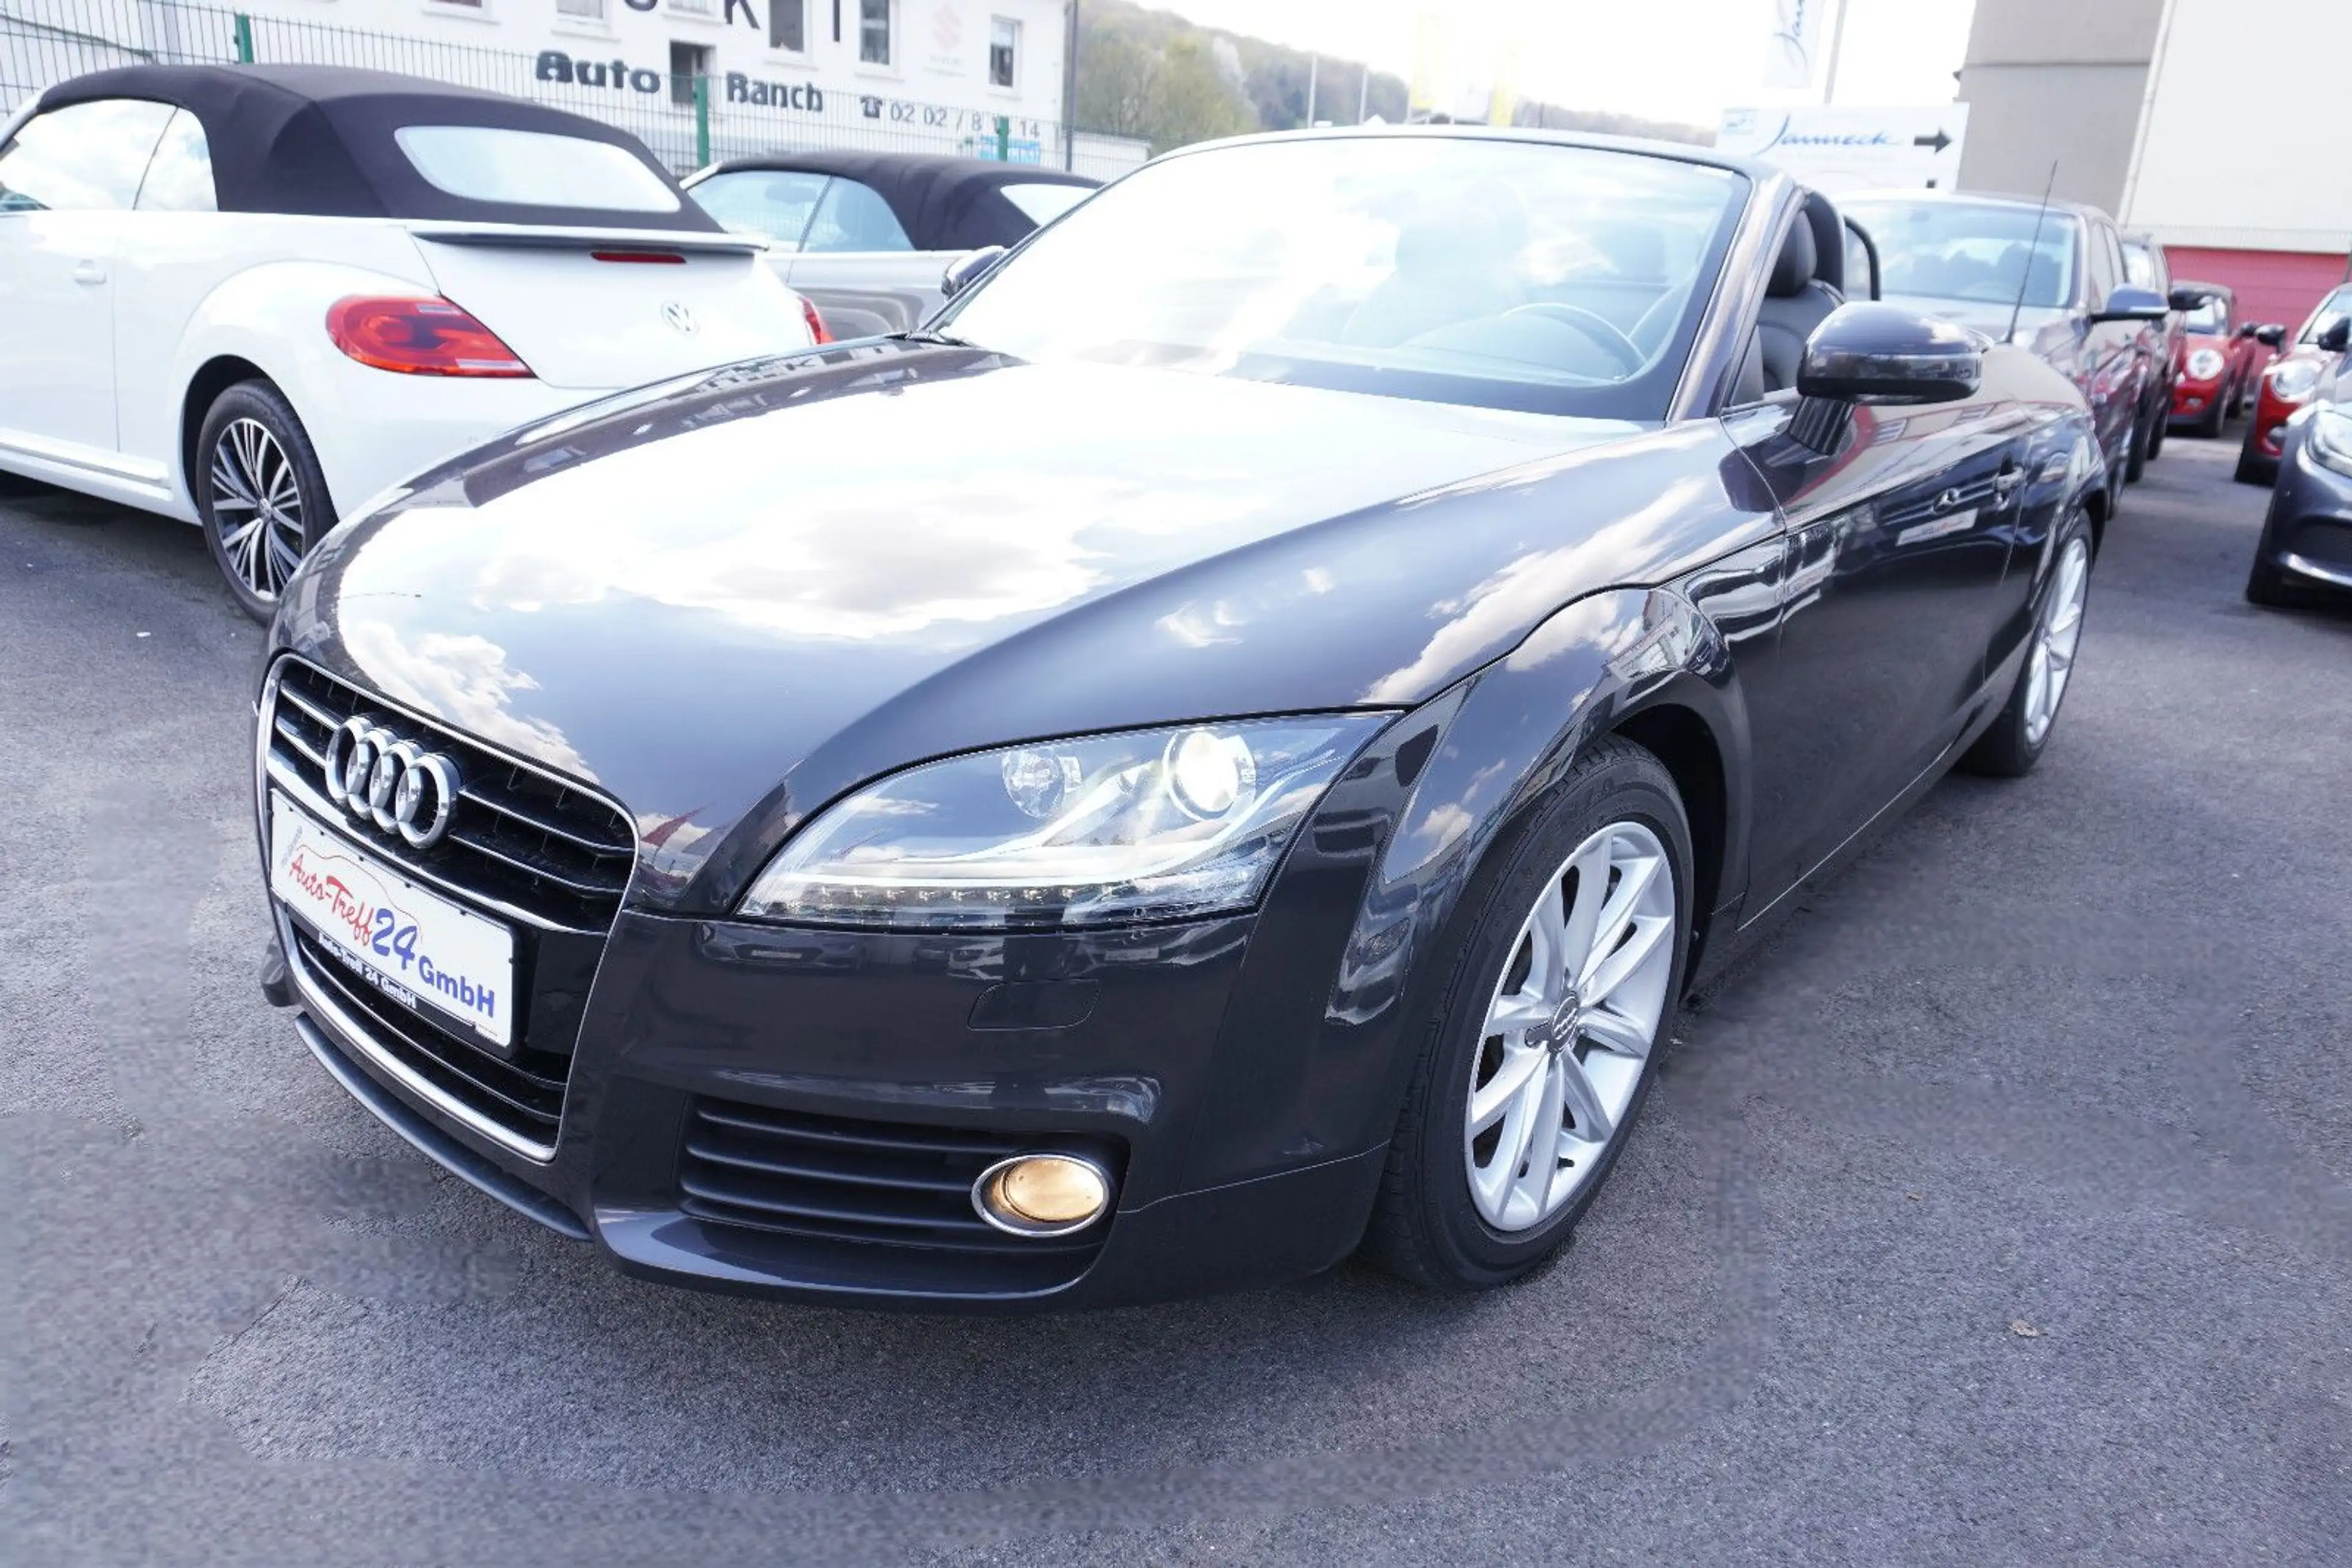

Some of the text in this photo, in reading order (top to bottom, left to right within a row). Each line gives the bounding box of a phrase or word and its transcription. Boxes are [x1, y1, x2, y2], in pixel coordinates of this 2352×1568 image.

[536, 50, 824, 113] Auto Ranch
[371, 908, 418, 971] 24
[419, 956, 494, 1017] GmbH
